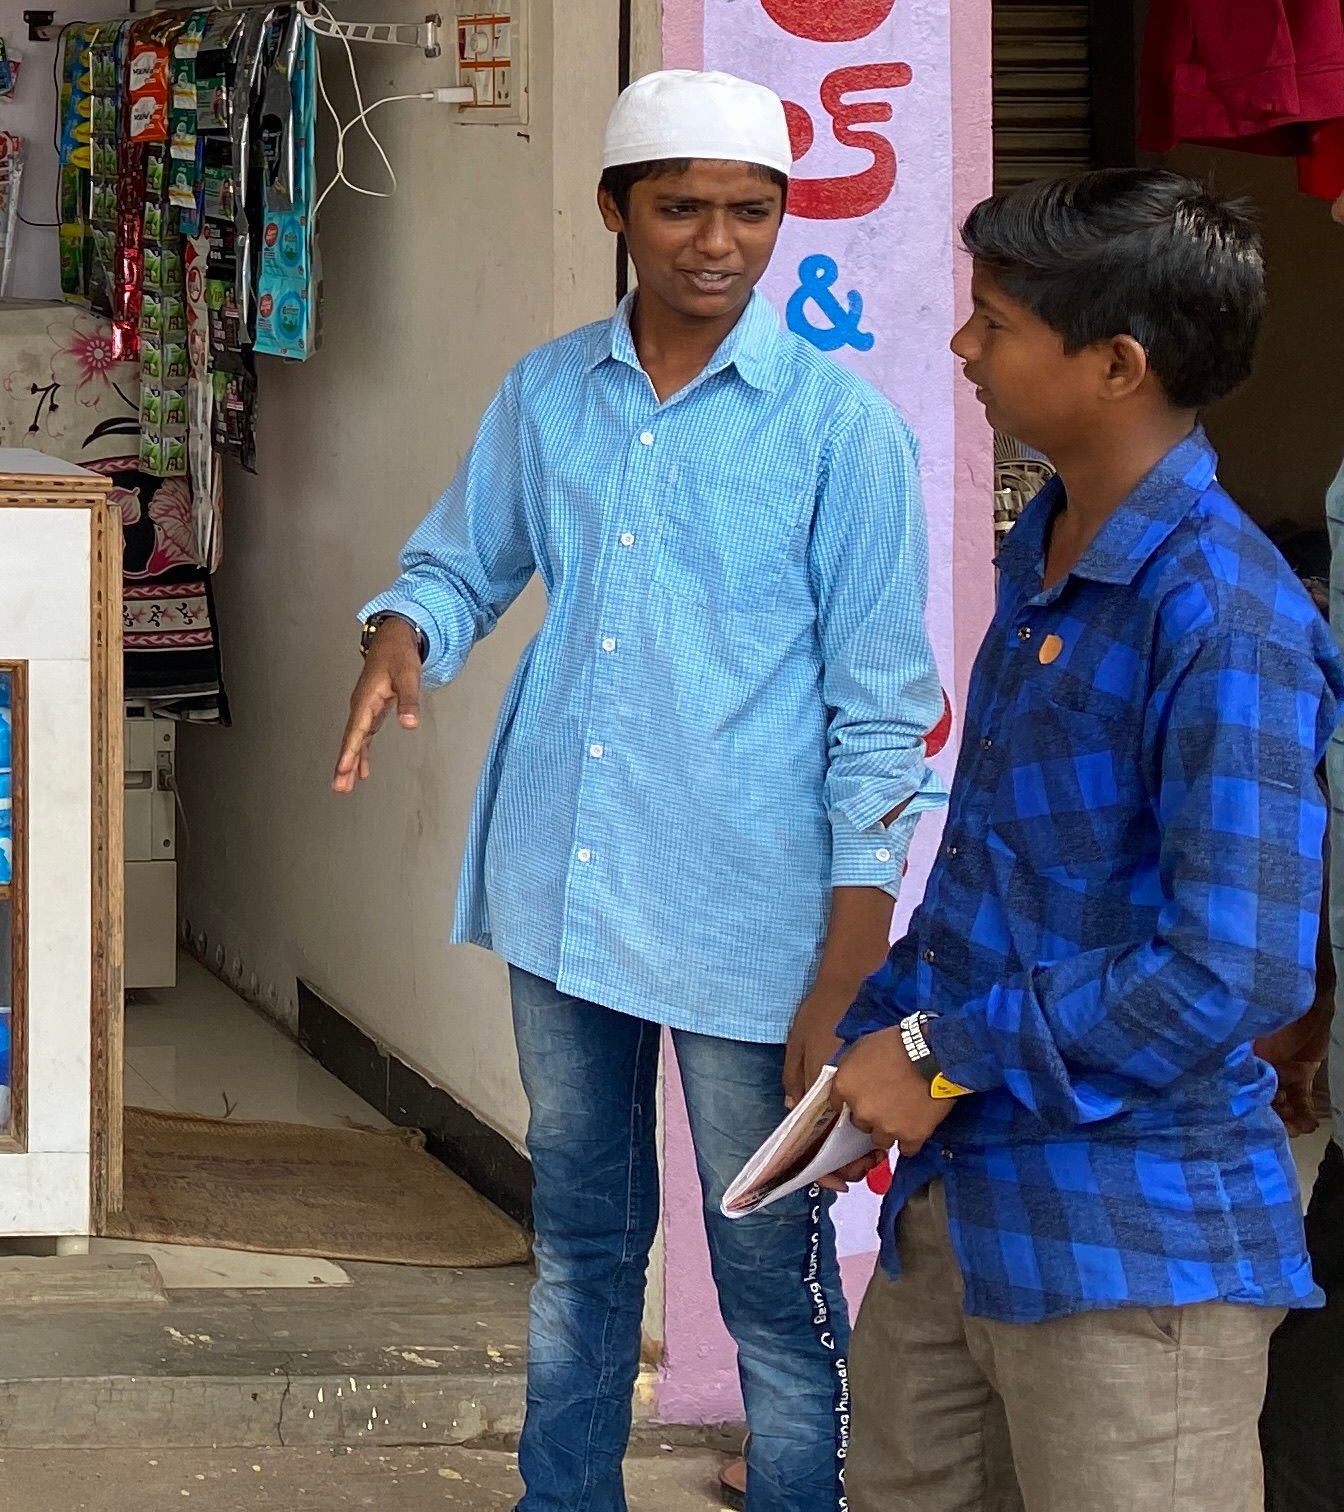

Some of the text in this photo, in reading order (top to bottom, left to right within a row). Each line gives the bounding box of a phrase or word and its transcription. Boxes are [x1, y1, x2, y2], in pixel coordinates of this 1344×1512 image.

[784, 253, 875, 353] &
[803, 1232, 828, 1325] Being human
[834, 1358, 850, 1413] human
